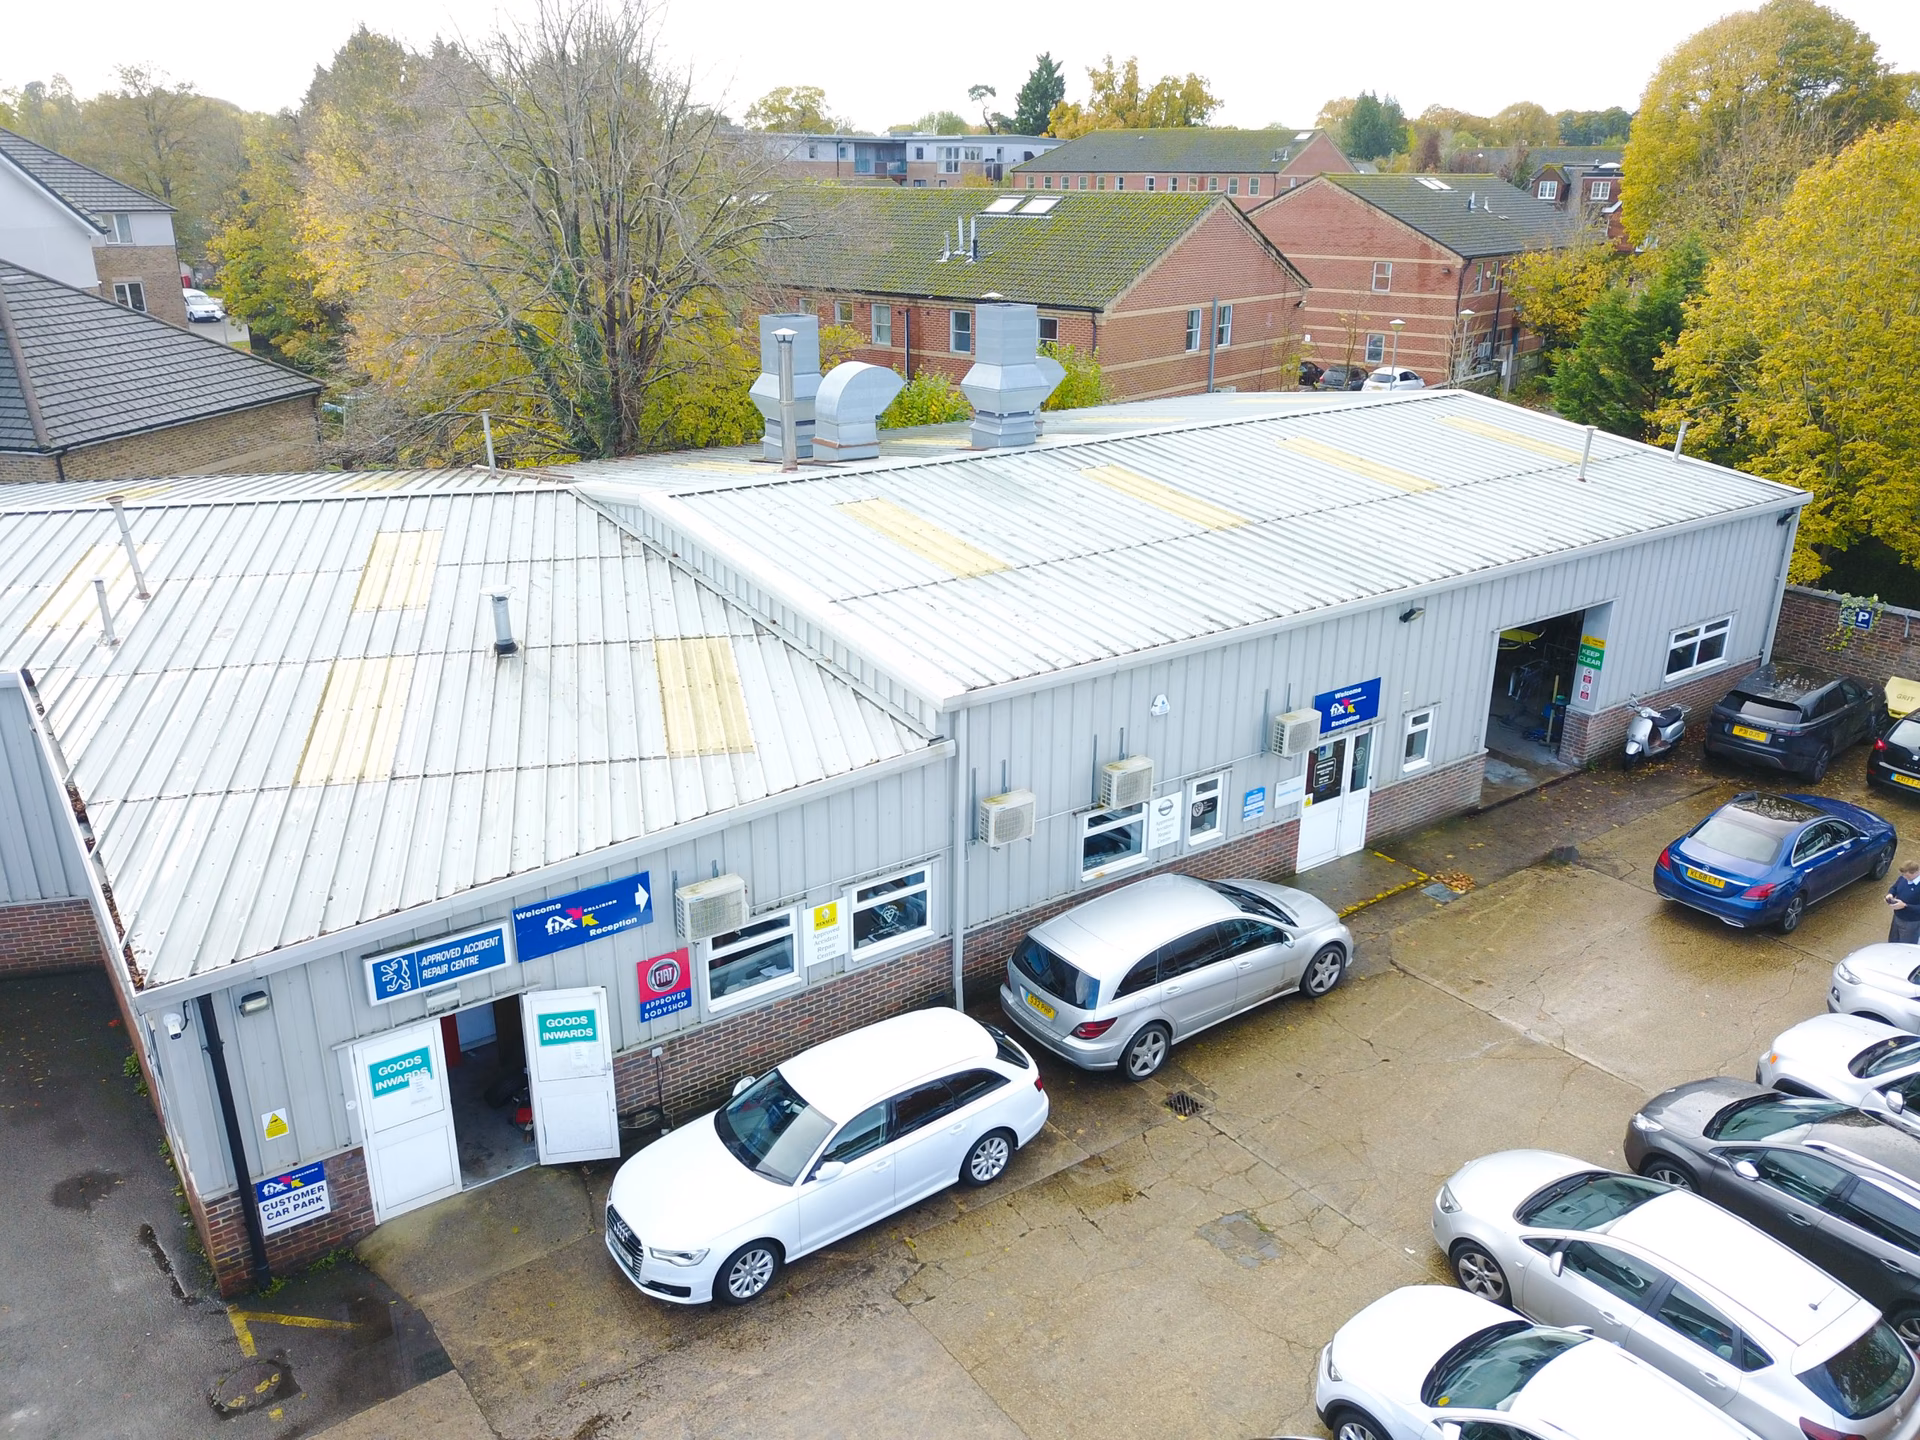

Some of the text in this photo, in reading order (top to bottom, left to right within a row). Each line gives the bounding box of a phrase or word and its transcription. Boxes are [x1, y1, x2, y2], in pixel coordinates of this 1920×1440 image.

[1858, 612, 1870, 622] P
[1582, 648, 1600, 658] KEEP
[1578, 656, 1601, 666] CLEAR
[1334, 688, 1362, 699] Welcome
[1896, 694, 1914, 702] GRIT
[1331, 715, 1360, 727] Reception
[516, 903, 561, 920] Welcome
[584, 900, 617, 912] COLLISION
[545, 916, 578, 933] fix
[589, 917, 637, 936] Reception
[813, 926, 840, 940] Approved
[814, 934, 838, 946] Accident
[421, 936, 499, 966] APPROVED ACCIDENT
[817, 943, 835, 953] Repair
[817, 950, 836, 960] Centre
[422, 955, 479, 979] REPAIR CENTRE
[656, 967, 673, 984] FIAT
[646, 992, 686, 1010] APPROVED
[645, 1000, 688, 1019] BODYSHOP
[546, 1016, 588, 1028] GOODS
[543, 1028, 593, 1040] INWARDS
[378, 1055, 422, 1076] GOODS
[262, 1182, 288, 1196] fix
[262, 1185, 325, 1212] CUSTOMER
[267, 1195, 323, 1220] CAR PARK
